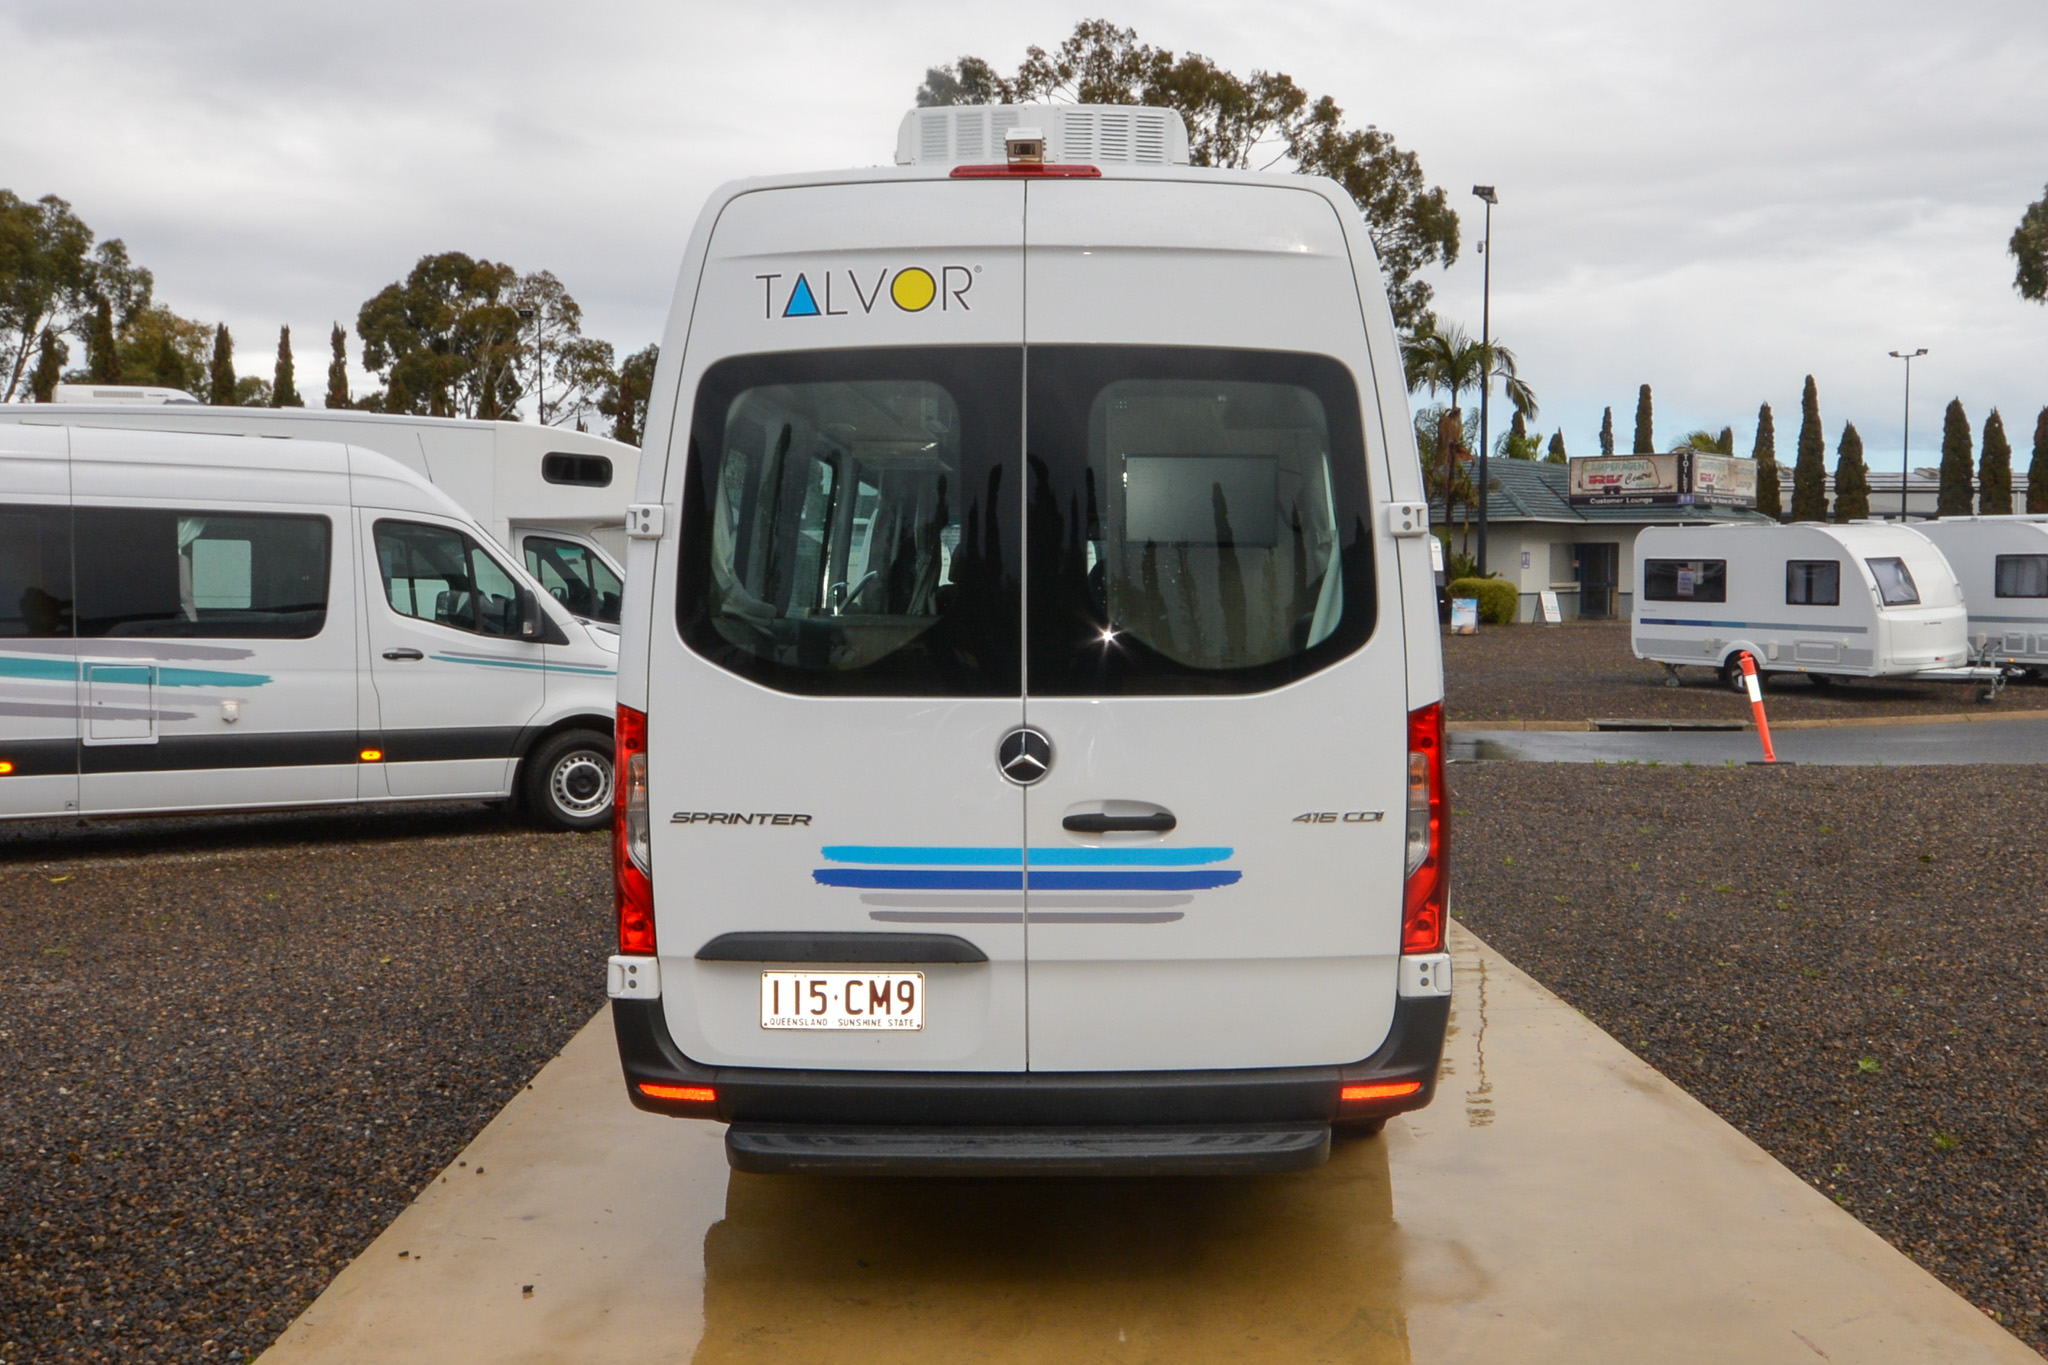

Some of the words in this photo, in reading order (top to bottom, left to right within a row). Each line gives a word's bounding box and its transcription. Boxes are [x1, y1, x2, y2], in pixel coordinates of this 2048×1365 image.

[755, 265, 973, 319] TALVOR
[1589, 474, 1622, 484] RV
[1700, 472, 1715, 482] RV
[1590, 497, 1624, 505] Customer
[670, 812, 812, 826] SPRINTER
[1292, 812, 1338, 823] 416
[1343, 811, 1384, 822] CDI
[769, 1018, 828, 1026] QUEENSLAND
[838, 1019, 882, 1027] SUNSHINE
[888, 1019, 914, 1027] STATE
